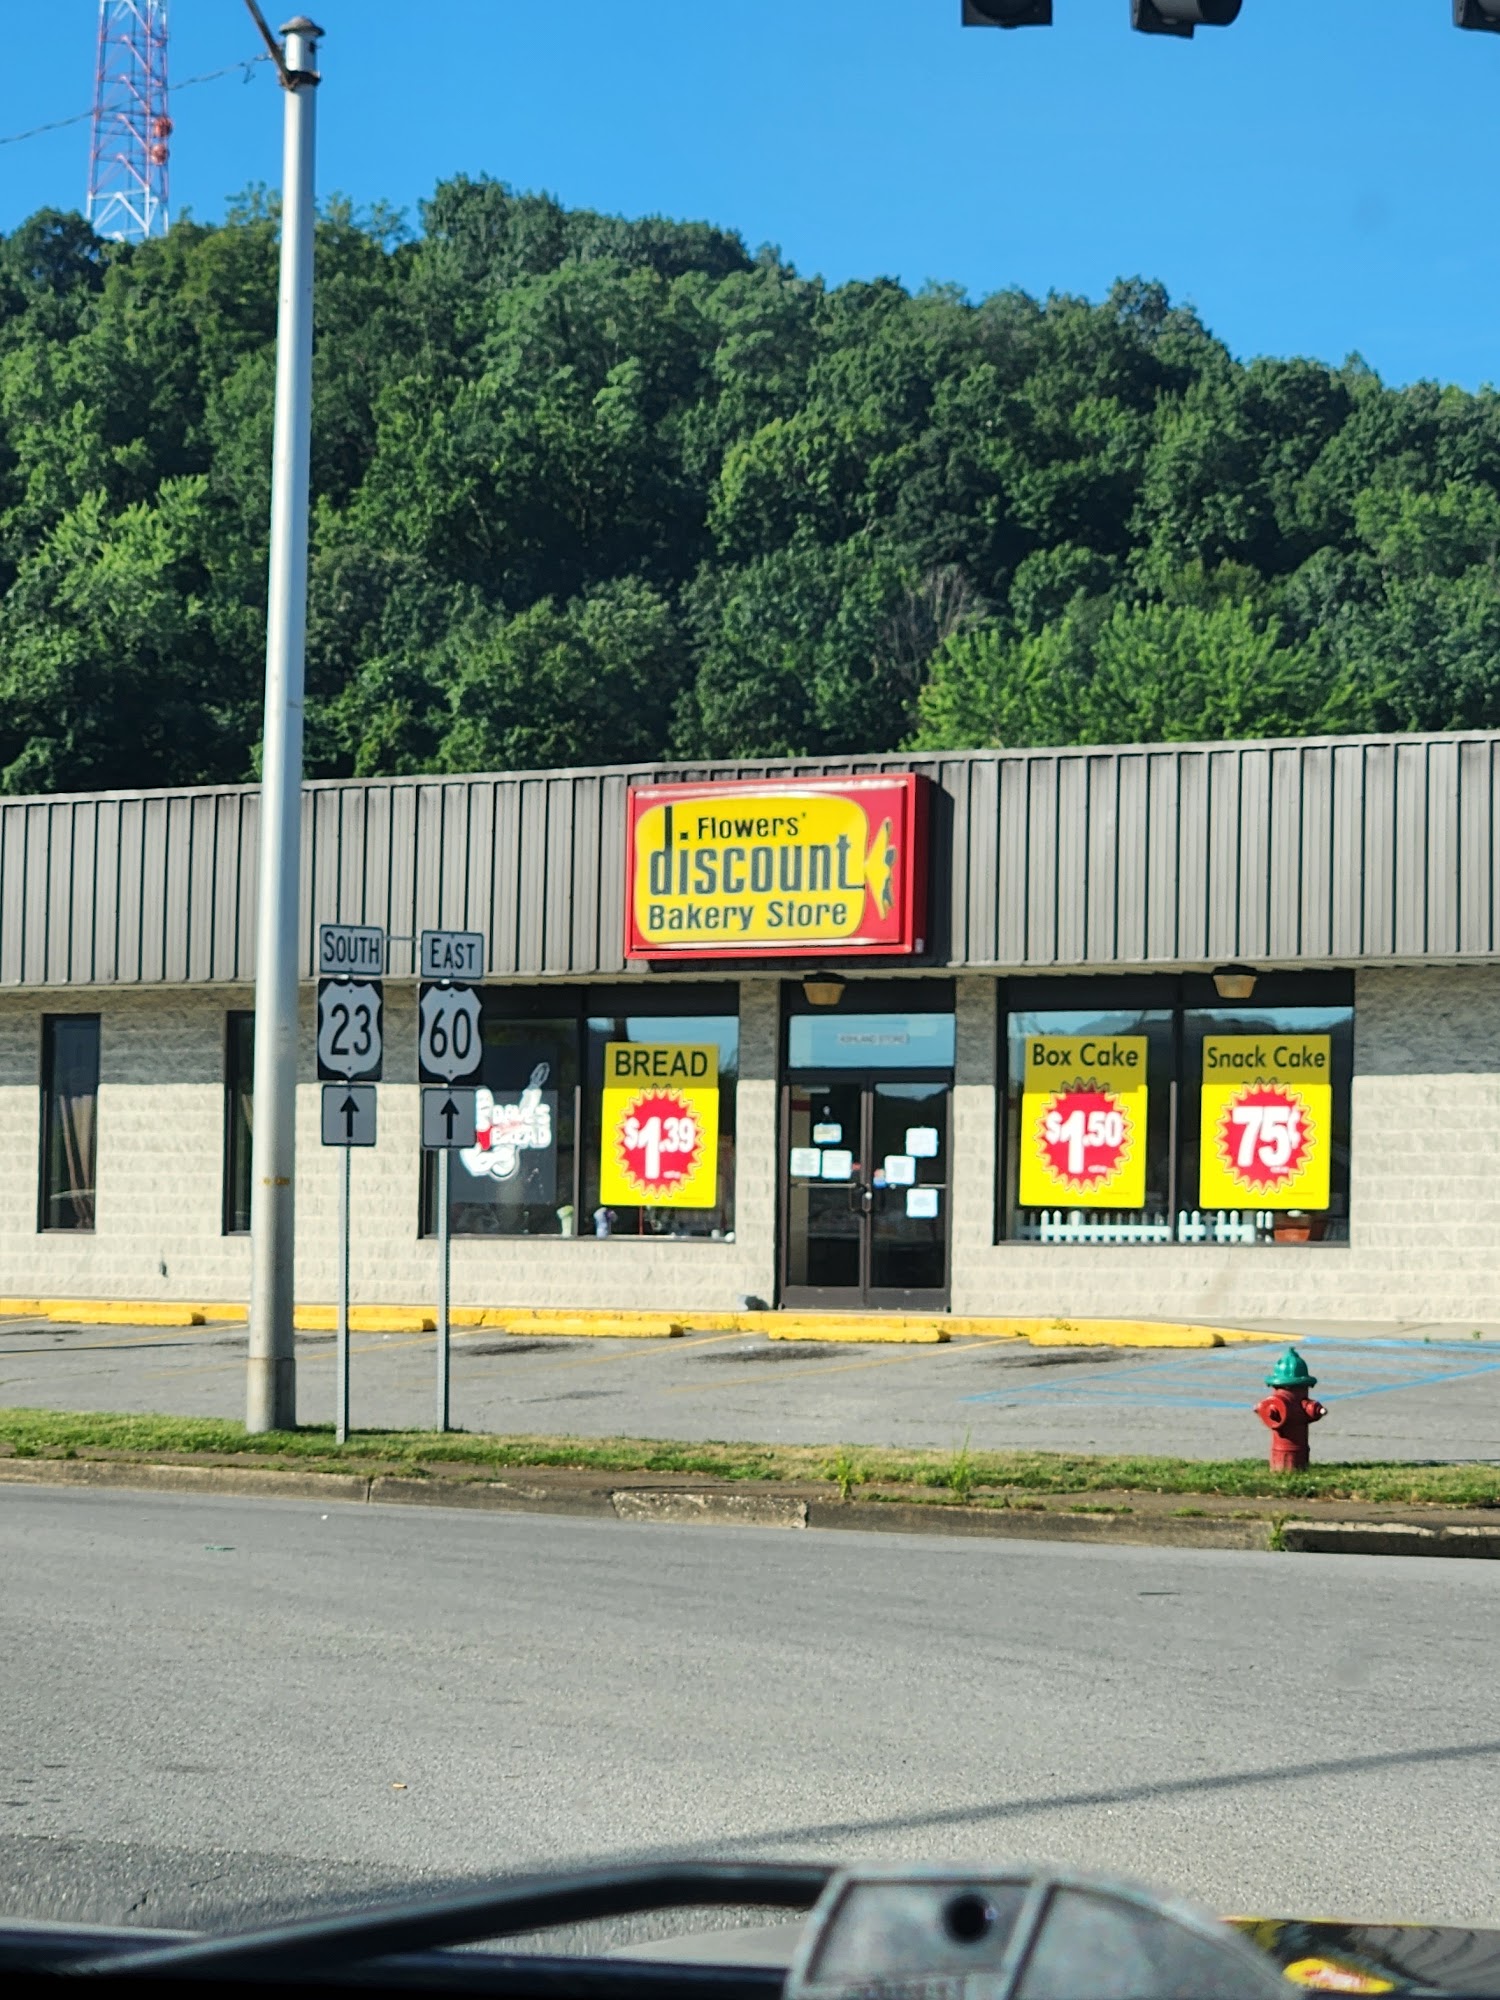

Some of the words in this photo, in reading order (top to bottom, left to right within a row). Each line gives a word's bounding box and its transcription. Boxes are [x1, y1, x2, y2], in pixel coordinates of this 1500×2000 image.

[650, 805, 865, 896] discount
[648, 902, 754, 931] Bakery
[767, 900, 848, 928] Store
[322, 930, 380, 965] SOUTH
[430, 938, 476, 970] EAST
[330, 1003, 372, 1056] 23
[429, 1007, 472, 1060] 60
[615, 1050, 708, 1077] BREAD
[1032, 1042, 1072, 1067] Box
[1079, 1041, 1139, 1067] Cake
[1207, 1046, 1266, 1069] Snack
[1273, 1045, 1326, 1068] Cake
